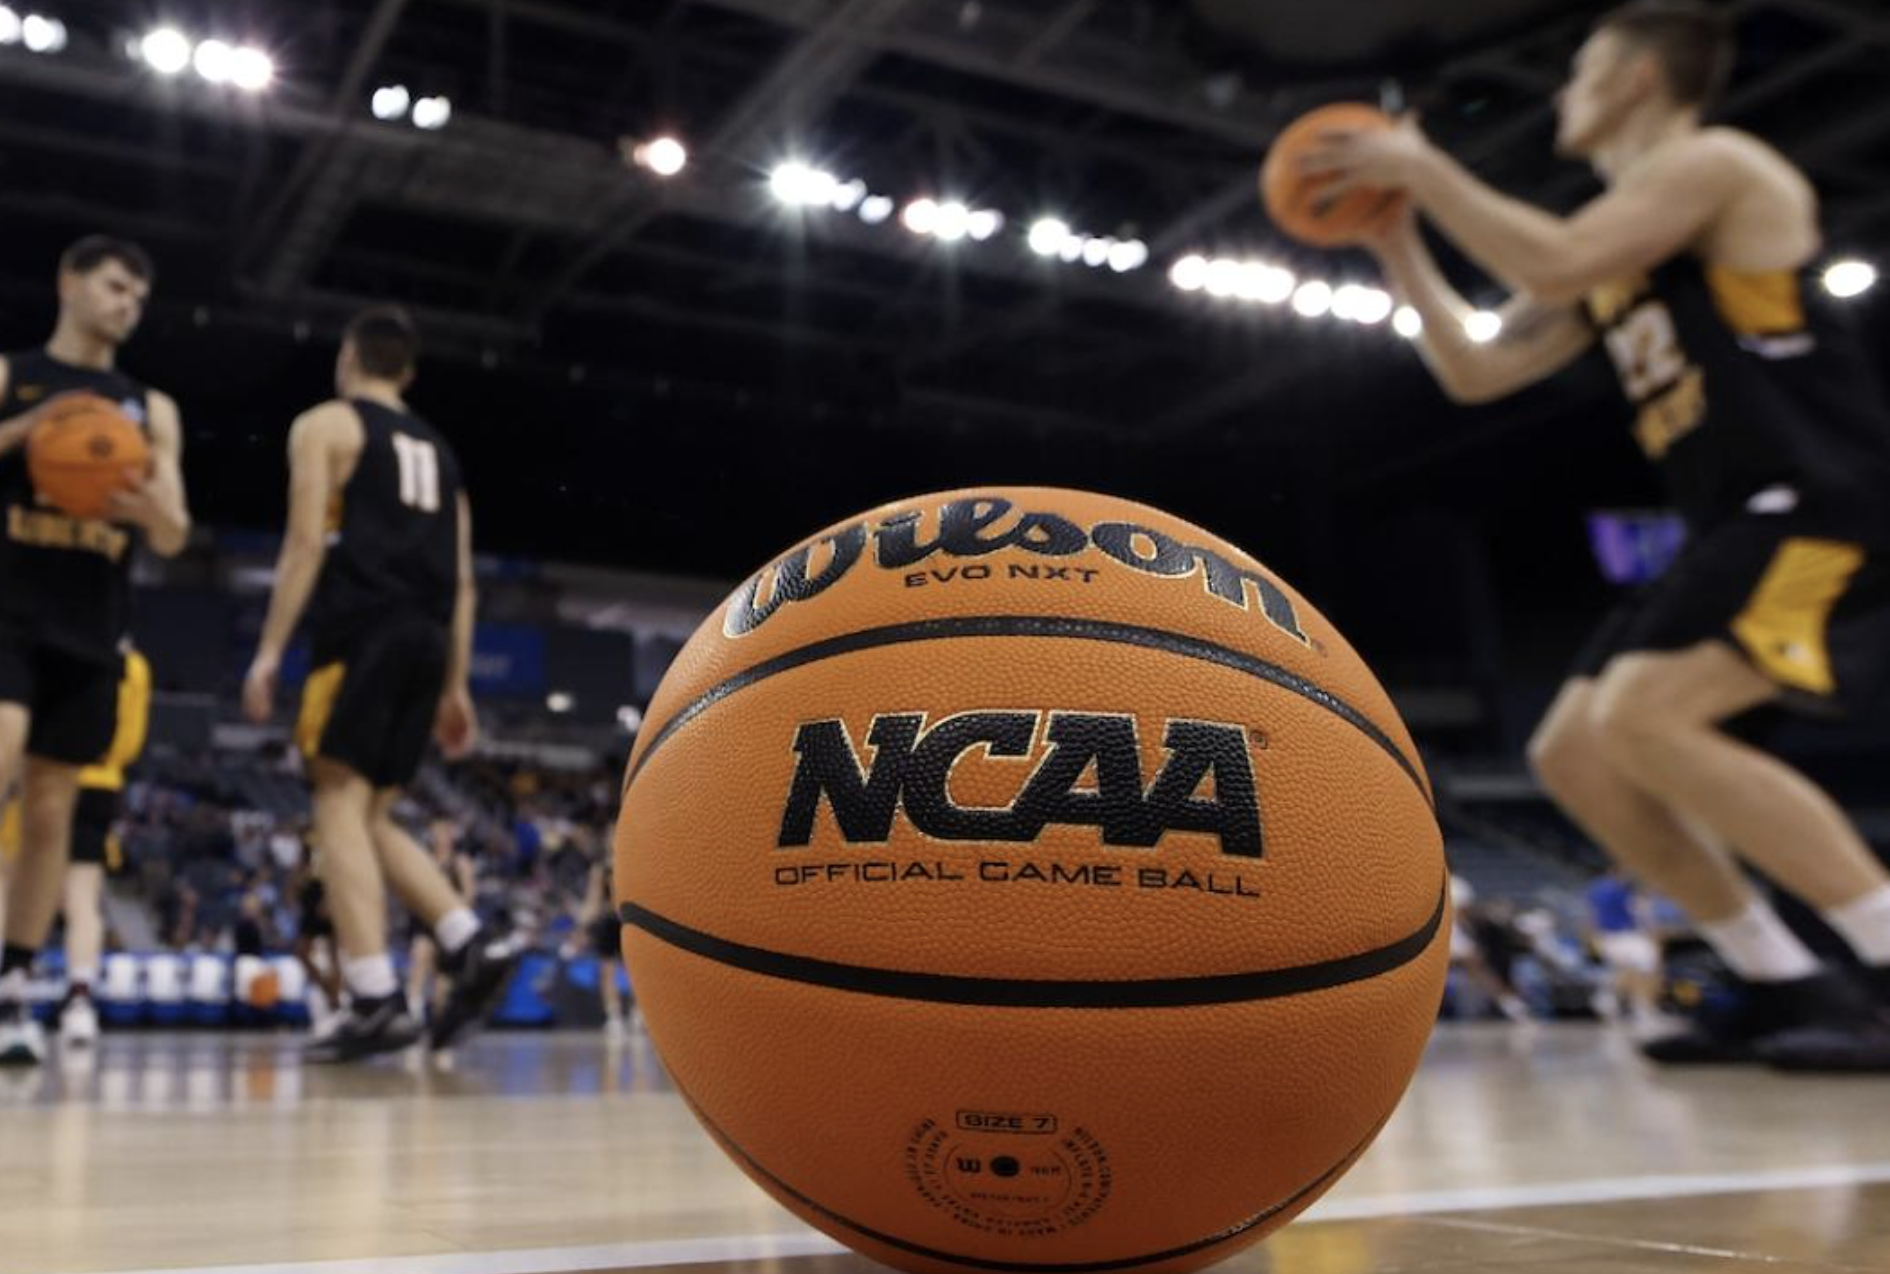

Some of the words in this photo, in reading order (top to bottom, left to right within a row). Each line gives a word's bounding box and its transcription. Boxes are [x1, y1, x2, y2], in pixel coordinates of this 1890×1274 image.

[391, 430, 440, 513] 11
[723, 496, 1313, 650] Wilson
[905, 564, 991, 588] EVO
[1008, 563, 1099, 583] NXT
[776, 709, 1265, 860] NCAA
[775, 860, 965, 886] OFFICIAL
[978, 860, 1122, 887] GAME
[1138, 867, 1260, 898] BALL
[964, 1114, 1024, 1129] SIZE
[1032, 1116, 1050, 1129] 7
